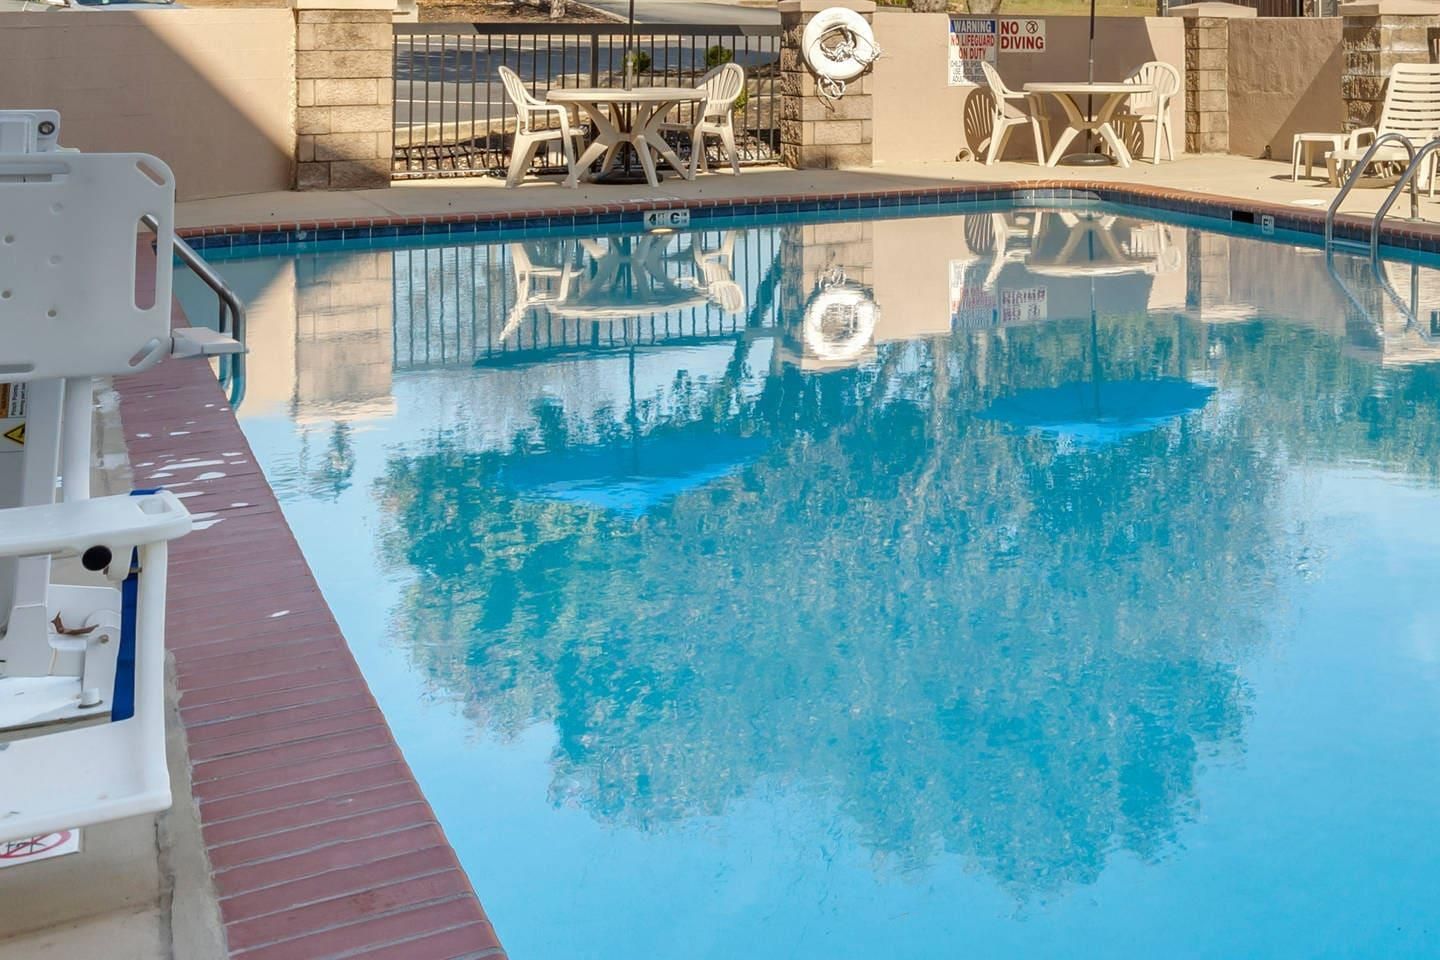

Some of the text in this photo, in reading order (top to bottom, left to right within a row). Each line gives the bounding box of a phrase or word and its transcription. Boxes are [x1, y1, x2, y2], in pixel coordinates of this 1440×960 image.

[954, 21, 992, 33] WARNING
[1001, 21, 1019, 35] NO
[951, 34, 994, 47] NO LIFEGUARD
[1001, 36, 1044, 50] DIVING
[959, 47, 986, 60] ON DUTY
